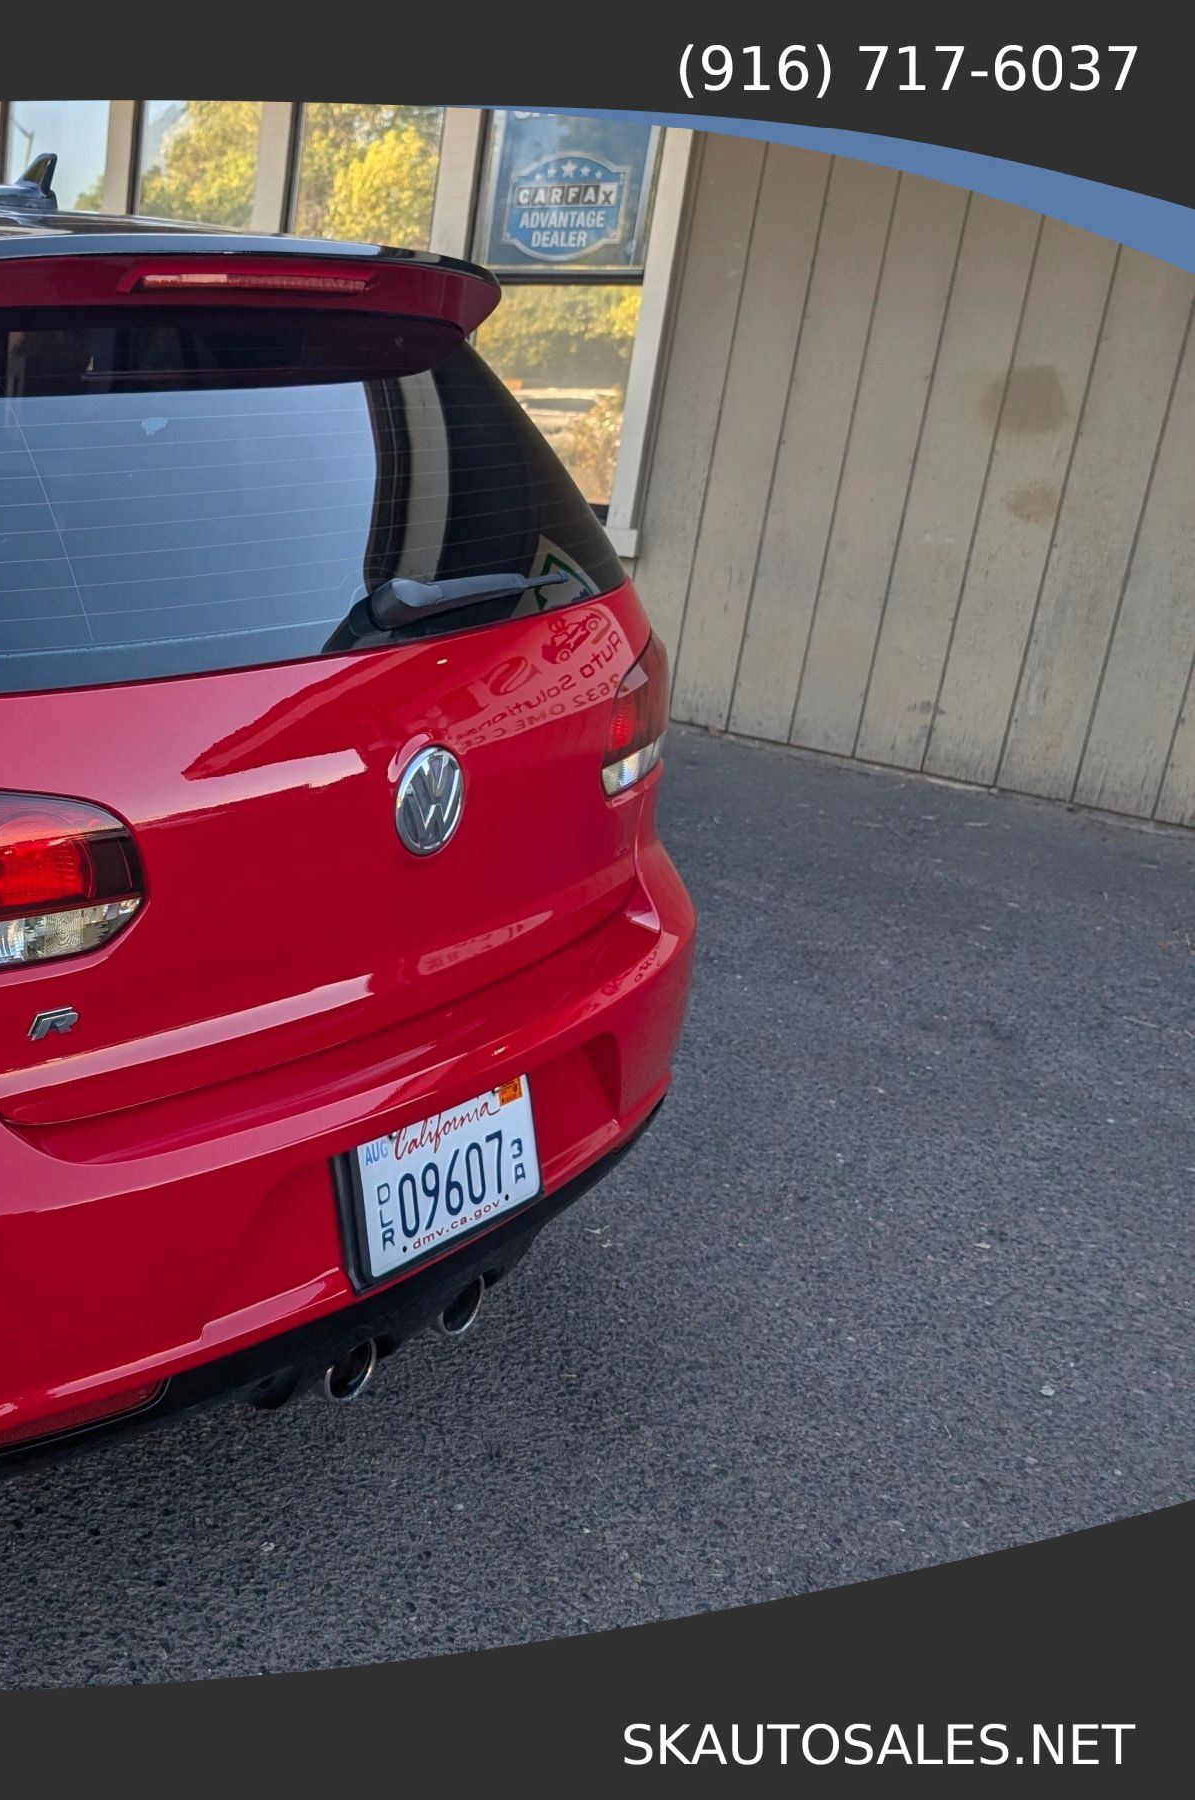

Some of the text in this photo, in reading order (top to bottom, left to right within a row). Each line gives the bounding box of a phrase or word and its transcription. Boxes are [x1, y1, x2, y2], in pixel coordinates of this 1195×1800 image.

[517, 185, 615, 206] CARFAX
[519, 210, 606, 229] ADVANTAGE
[530, 230, 589, 249] DEALER
[27, 1006, 79, 1041] R
[393, 1096, 502, 1161] California
[364, 1137, 391, 1167] AUG
[397, 1129, 503, 1239] 09607
[376, 1182, 396, 1251] DLR
[412, 1198, 502, 1251] dmv.ca.gov
